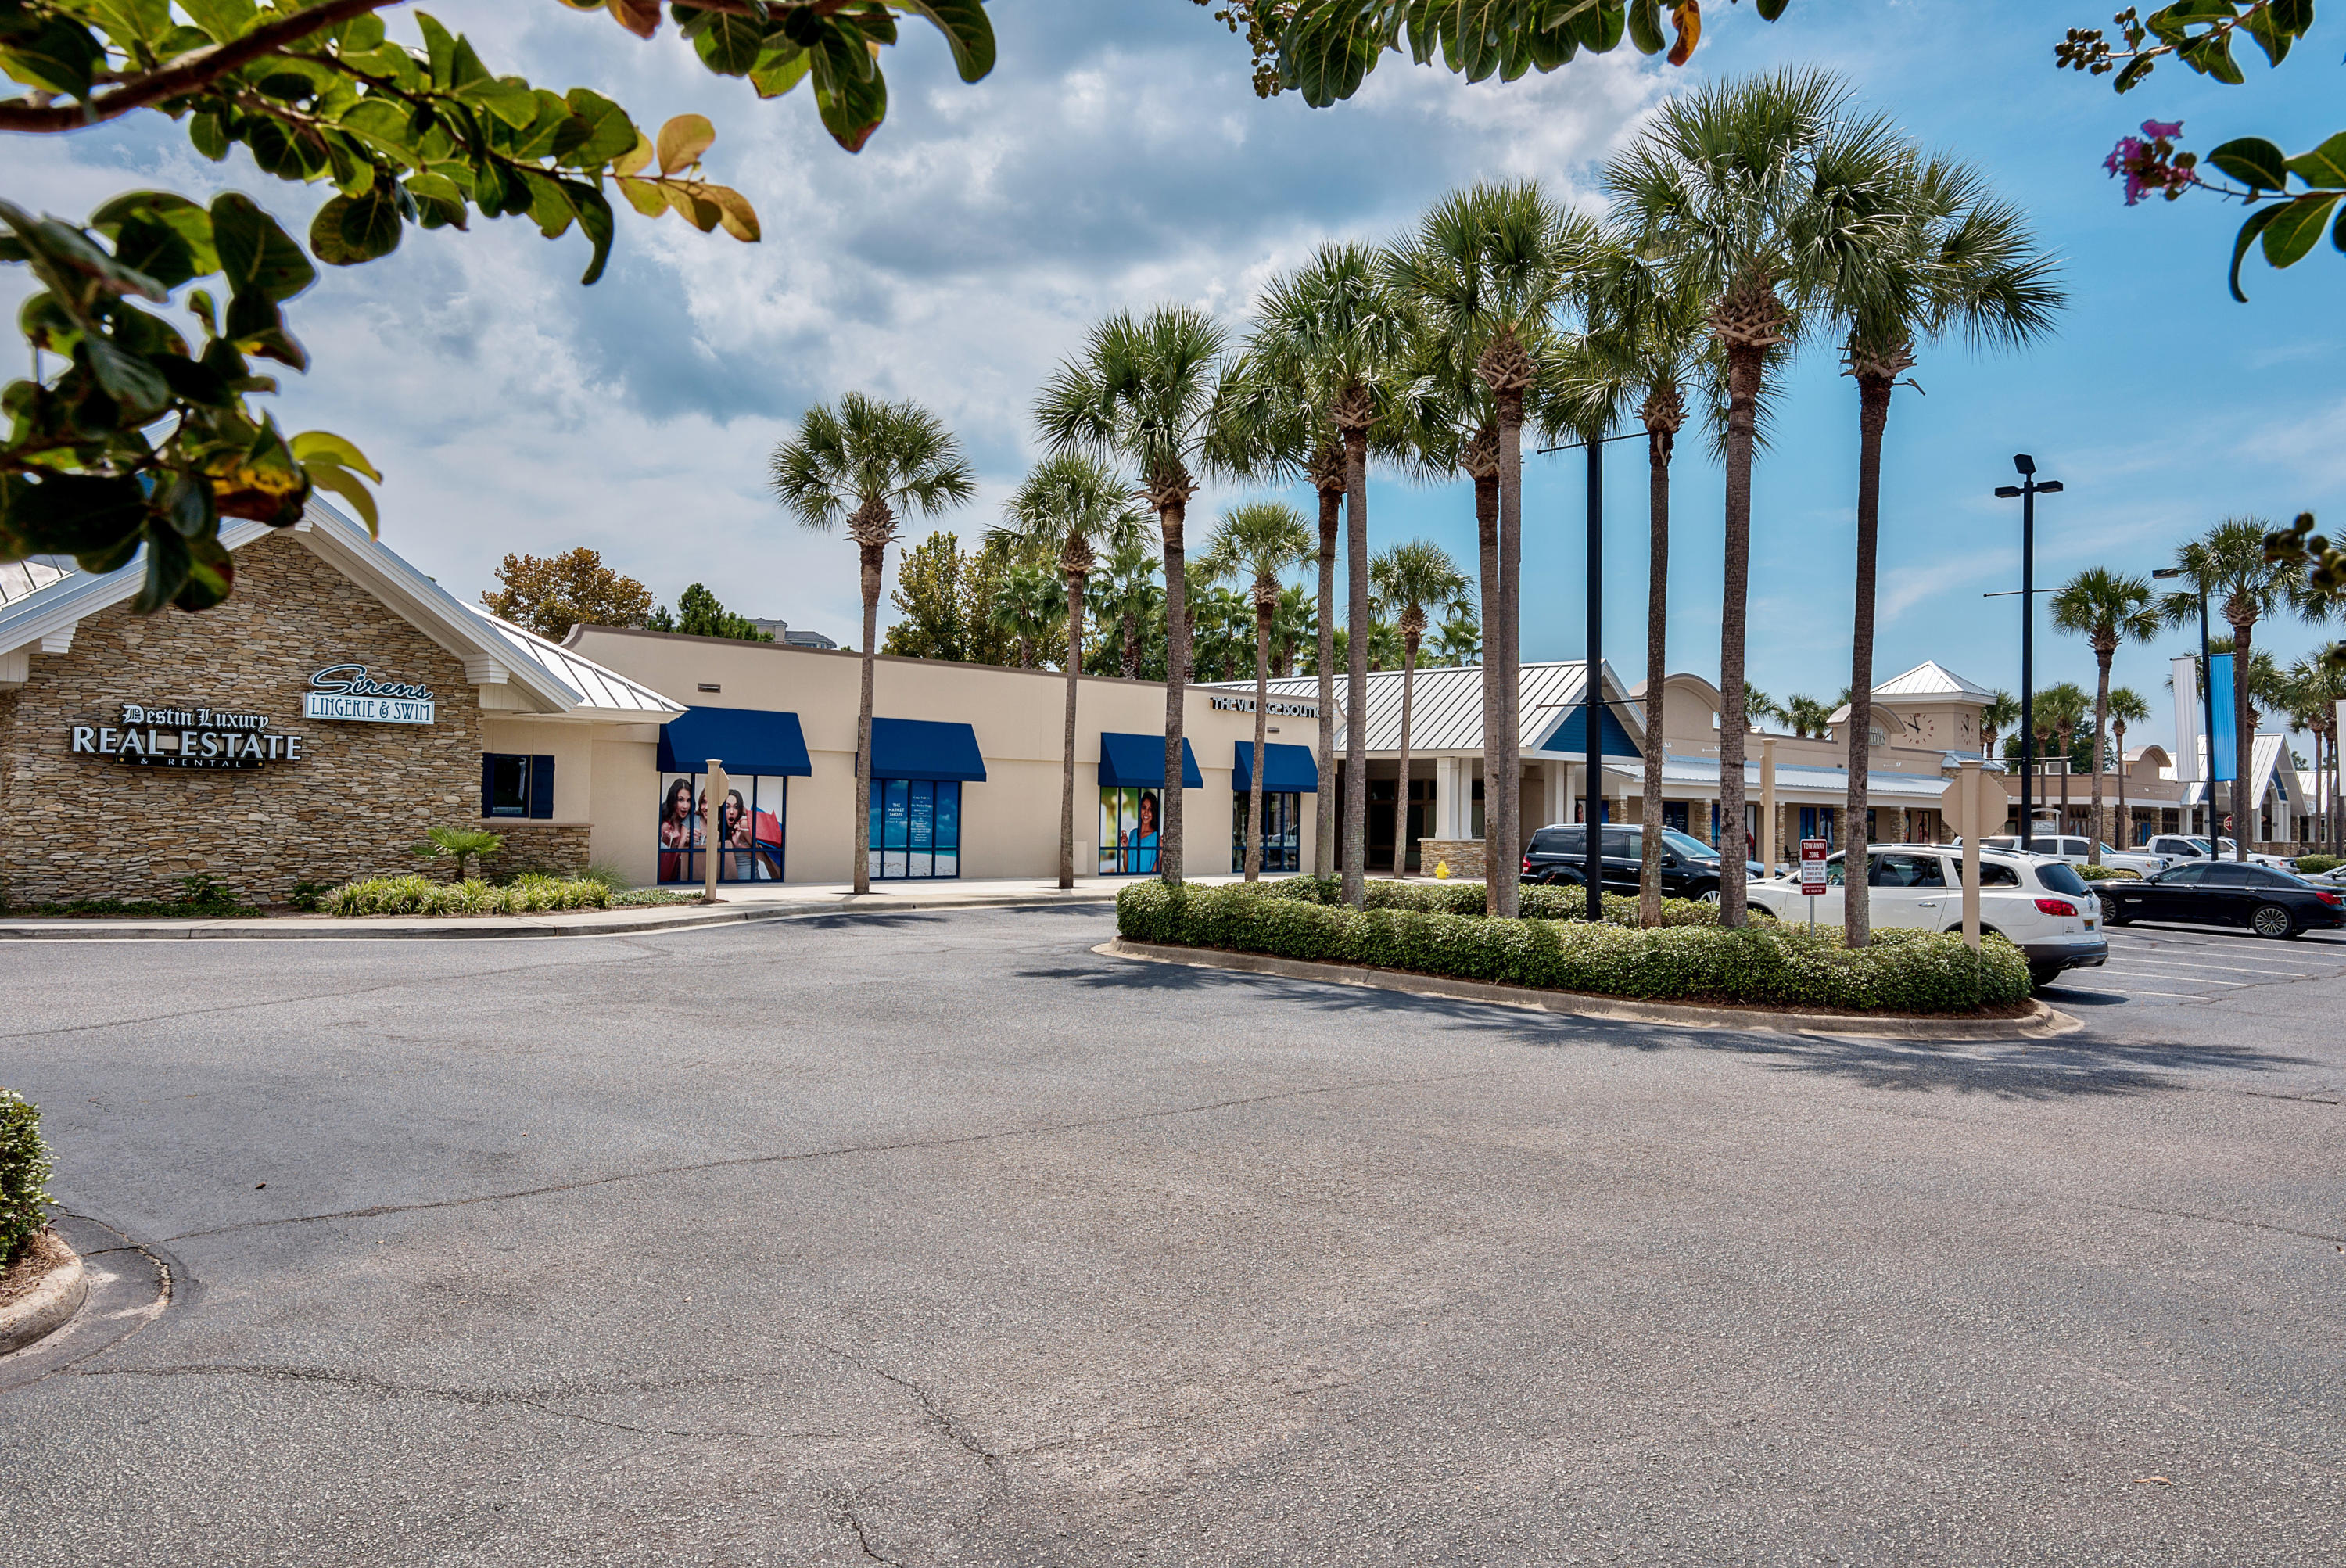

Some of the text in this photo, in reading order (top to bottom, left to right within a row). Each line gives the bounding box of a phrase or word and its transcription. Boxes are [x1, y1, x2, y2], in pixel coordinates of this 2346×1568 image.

[311, 664, 433, 700] Sirens
[122, 704, 269, 732] Destin Luxury
[311, 698, 430, 720] LINGERIE & SWIM
[1213, 697, 1237, 711] THE
[1237, 699, 1282, 715] VILLGE
[73, 726, 302, 759] REAL ESTATE
[168, 758, 241, 768] RENTAL
